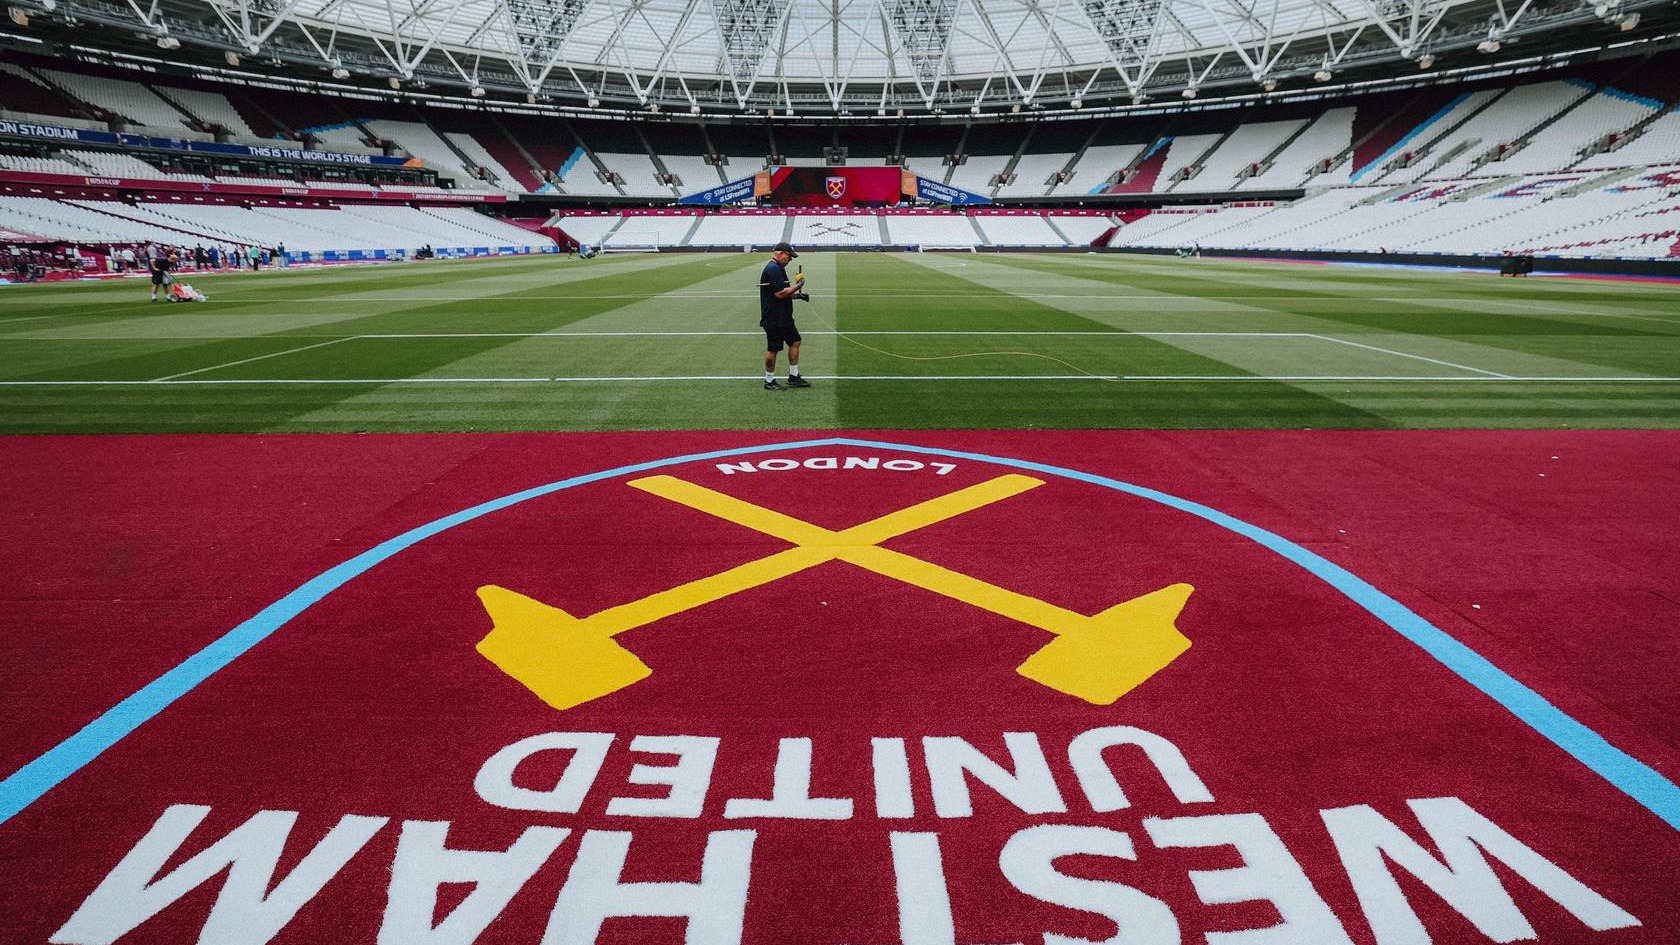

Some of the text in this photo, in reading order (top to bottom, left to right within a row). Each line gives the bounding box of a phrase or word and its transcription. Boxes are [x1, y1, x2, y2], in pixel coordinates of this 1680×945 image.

[19, 124, 78, 140] STADIUM
[248, 146, 371, 164] THIS IS THE WORLD'S STAGE
[715, 457, 957, 475] LONDON
[472, 725, 1216, 820] UNITED
[48, 803, 757, 945] HAM
